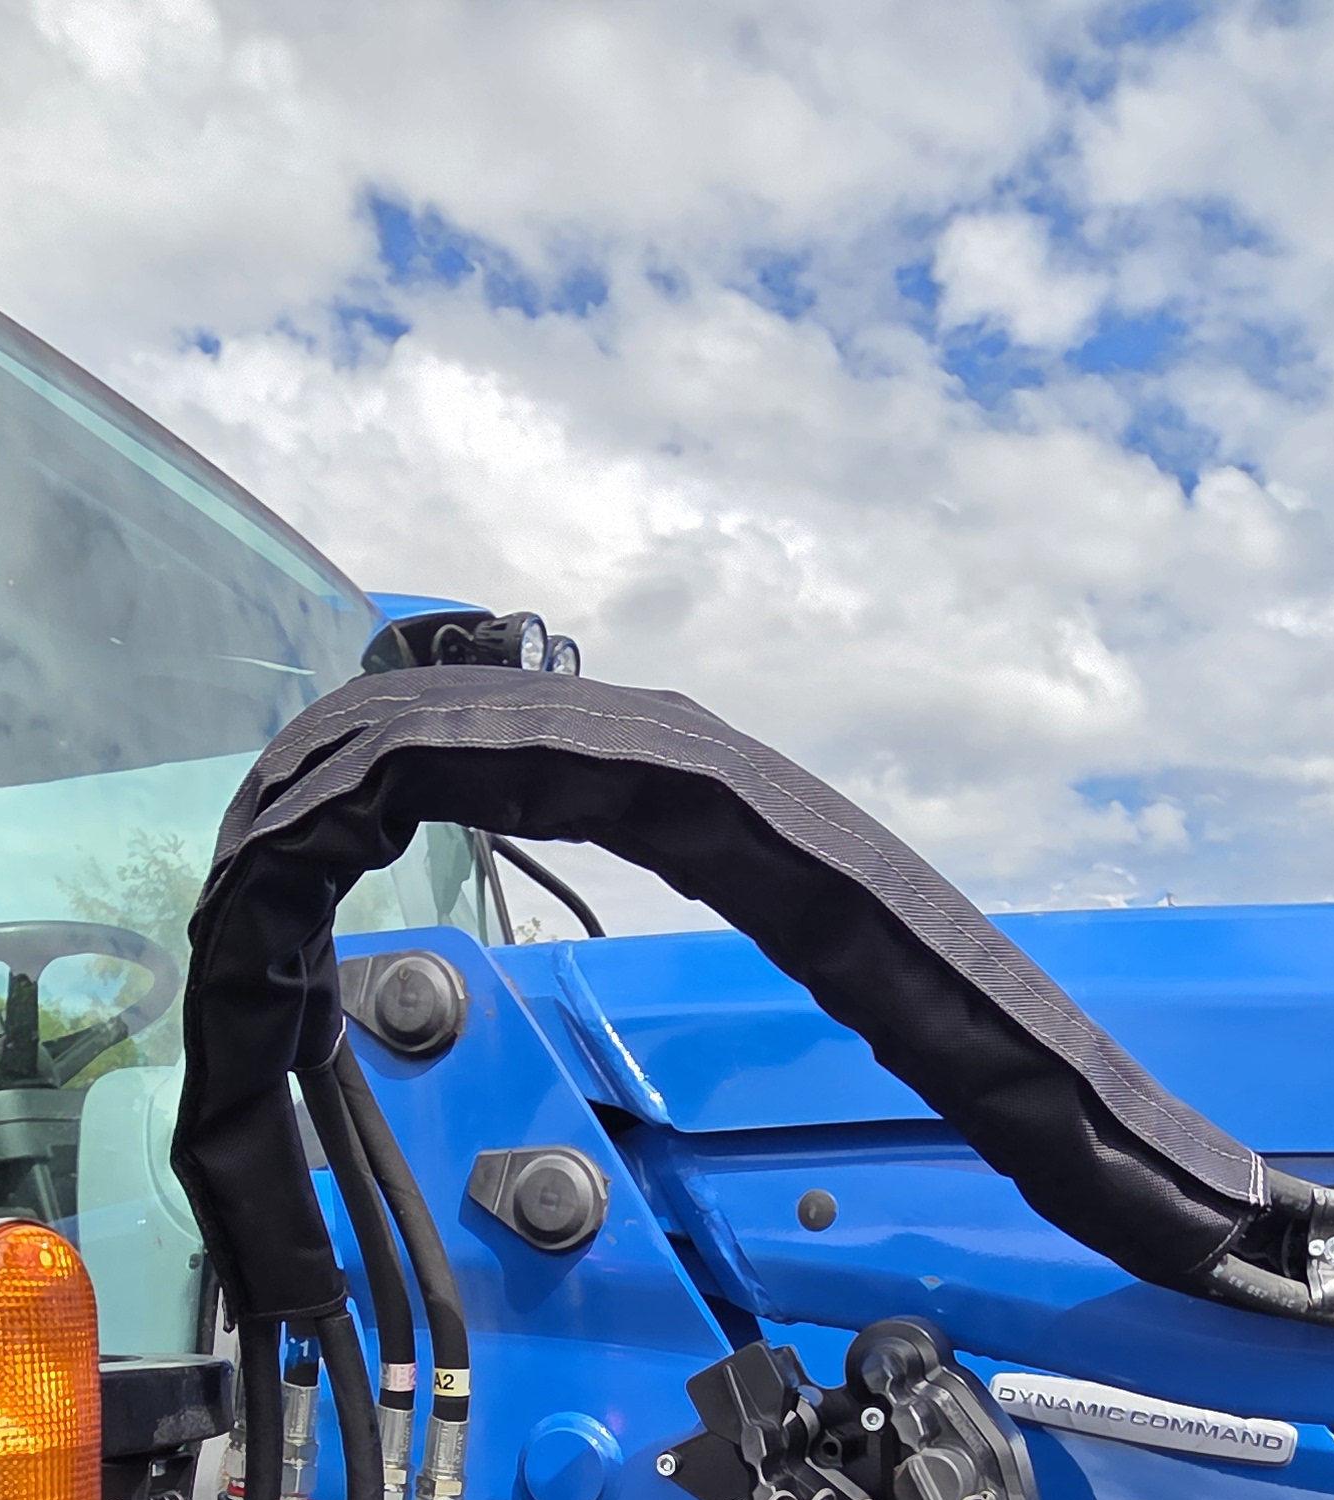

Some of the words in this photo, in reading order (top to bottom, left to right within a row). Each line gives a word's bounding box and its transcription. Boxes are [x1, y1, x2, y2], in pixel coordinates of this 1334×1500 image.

[434, 1372, 454, 1390] A2
[998, 1386, 1124, 1423] DYNAMIC
[1130, 1410, 1283, 1451] COMMAND
